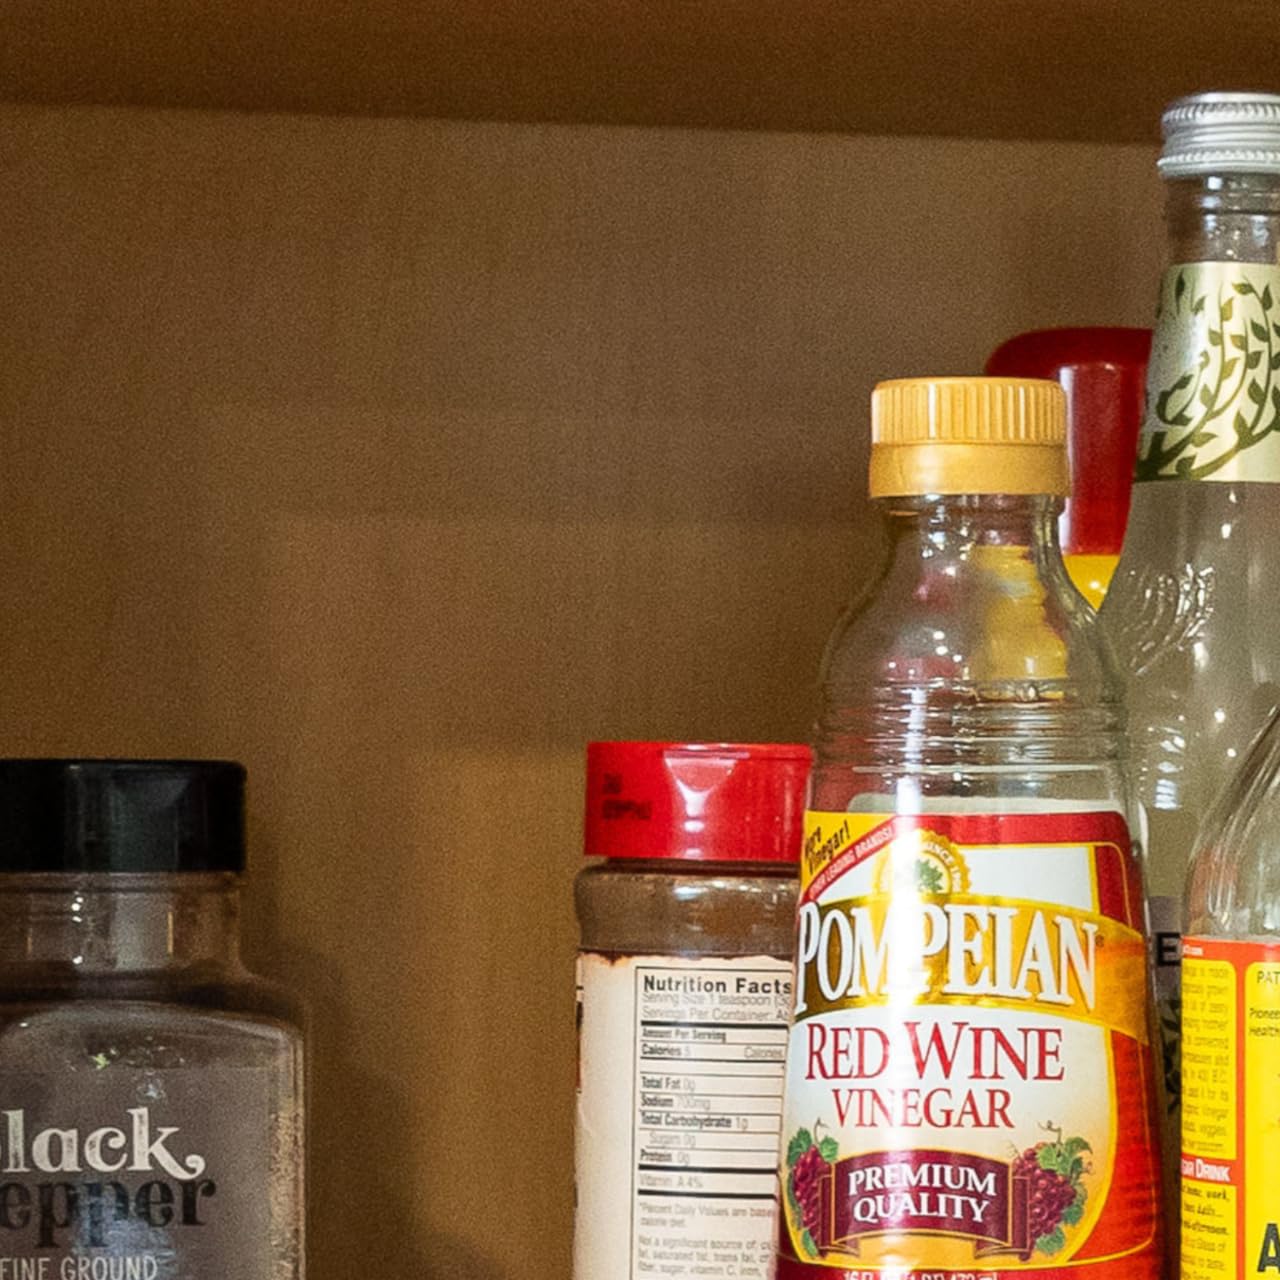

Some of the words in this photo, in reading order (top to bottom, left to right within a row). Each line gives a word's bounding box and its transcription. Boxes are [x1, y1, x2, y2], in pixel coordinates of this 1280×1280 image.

[796, 901, 1099, 1013] POMPEIAN
[644, 975, 727, 994] Nutrition
[736, 978, 792, 994] Facts
[1249, 1026, 1280, 1037] Health
[805, 1022, 890, 1081] RED
[904, 1021, 1066, 1081] WINE
[831, 1088, 1015, 1129] VINEGAR
[0, 1107, 205, 1180] lack
[848, 1163, 998, 1197] PREMIUM
[853, 1194, 990, 1224] QUALITY
